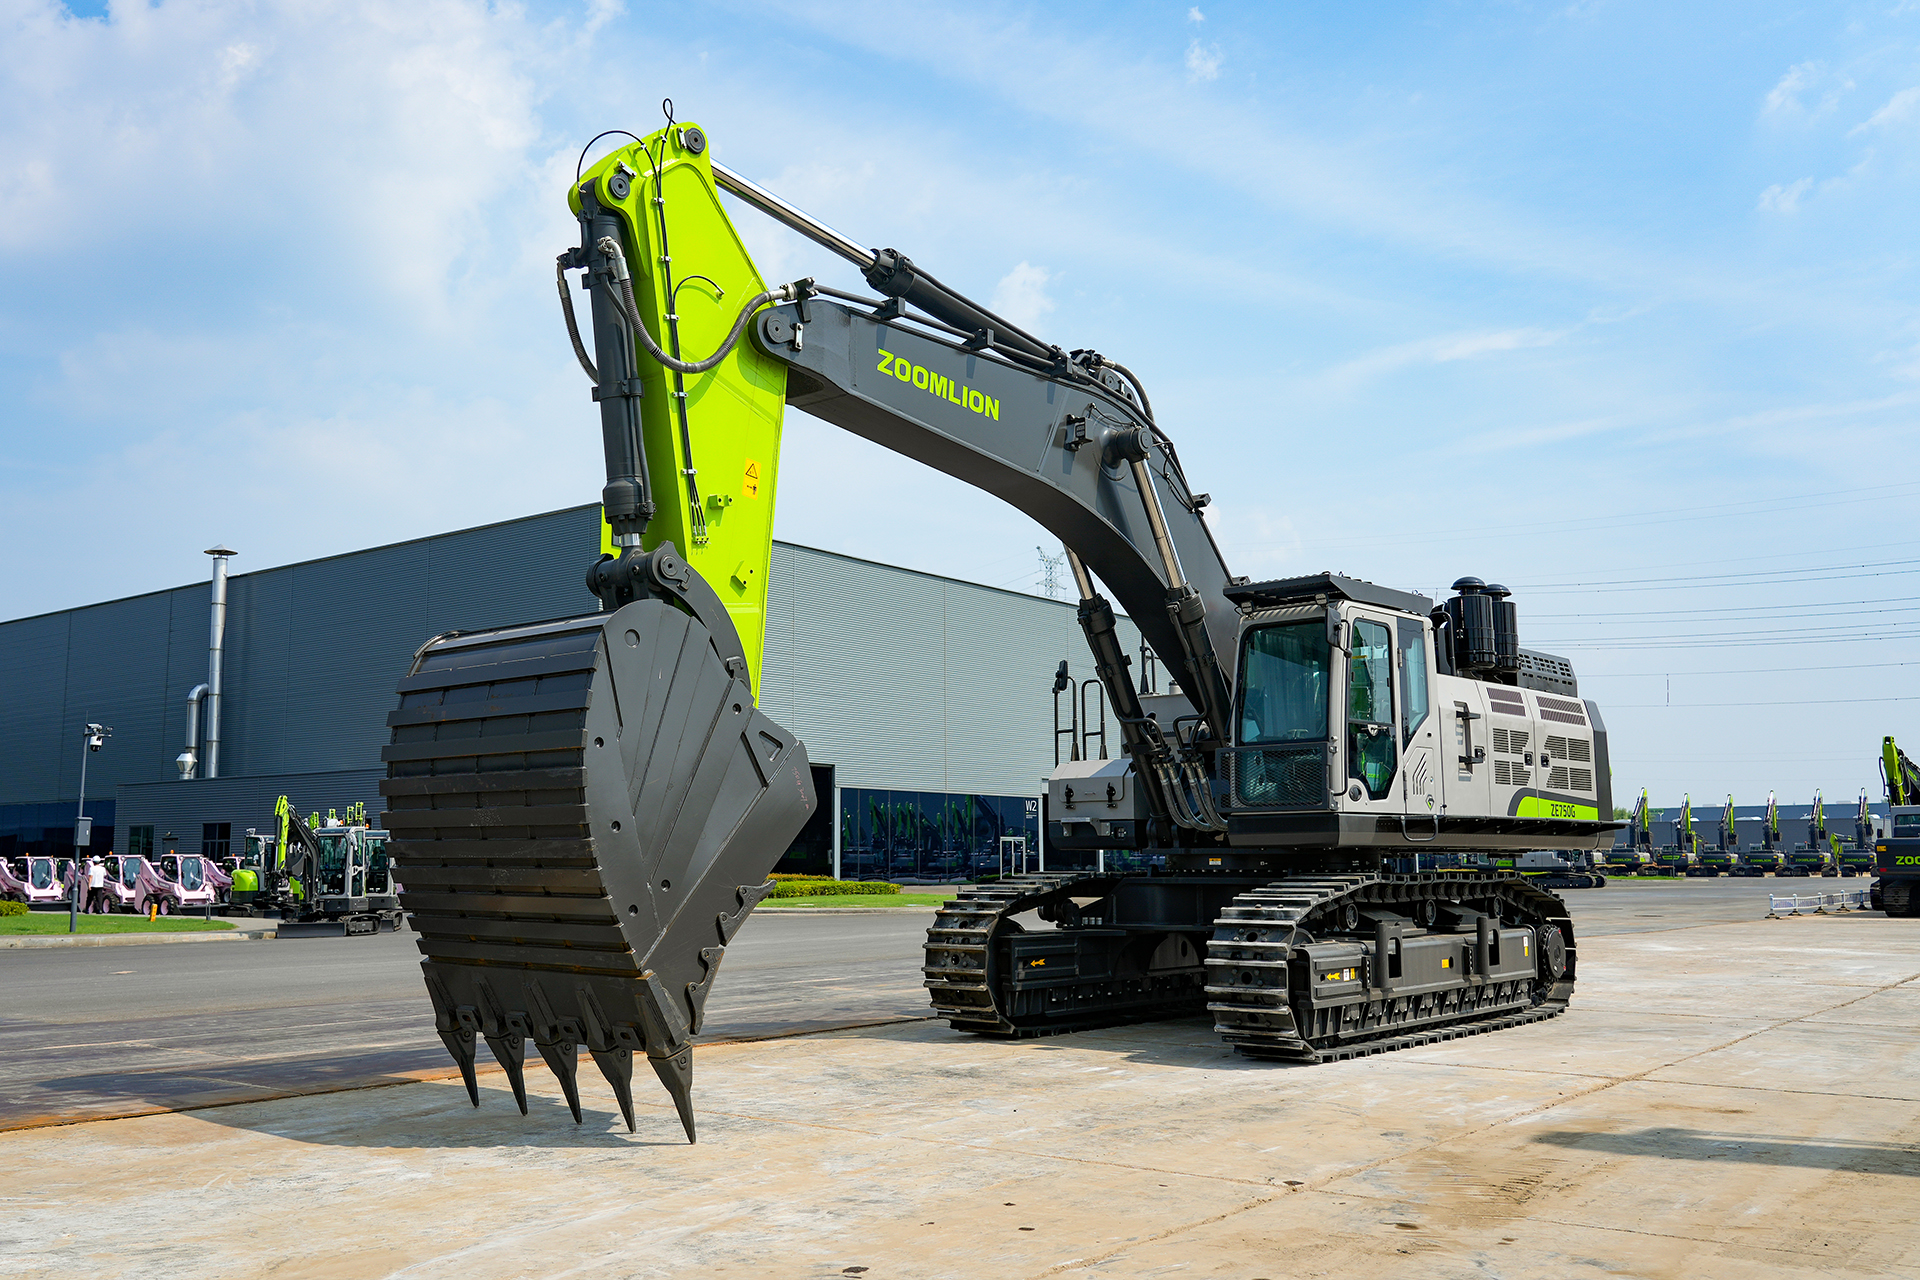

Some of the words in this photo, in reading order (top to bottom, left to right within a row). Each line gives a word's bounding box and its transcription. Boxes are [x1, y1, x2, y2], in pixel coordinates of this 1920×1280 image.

[876, 348, 1000, 421] ZOOMLION
[1025, 800, 1038, 812] W2
[1550, 804, 1576, 818] ZE750G
